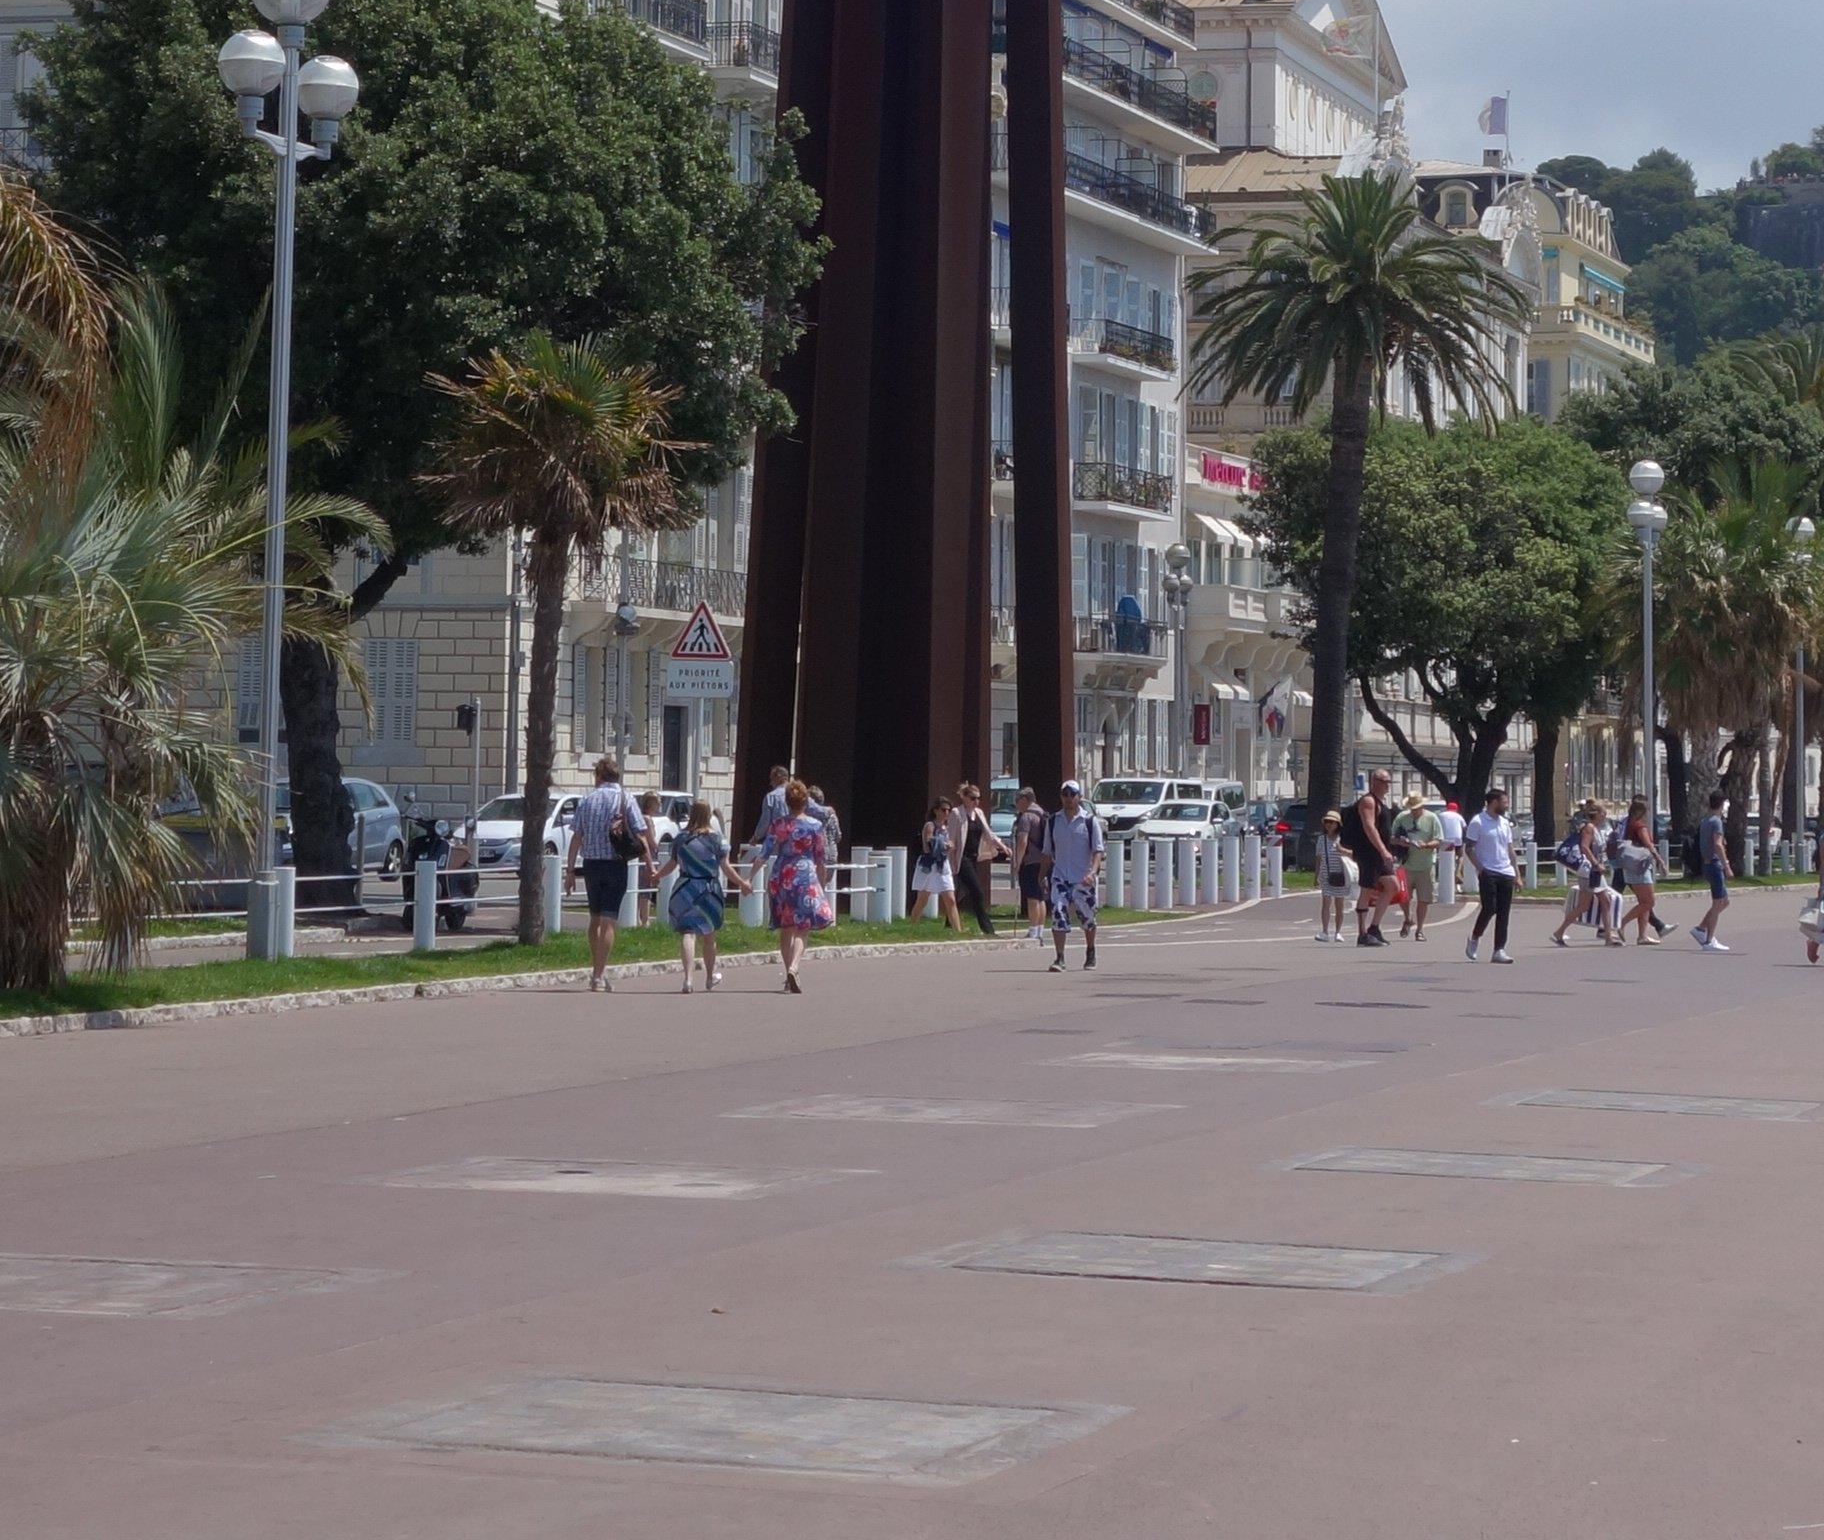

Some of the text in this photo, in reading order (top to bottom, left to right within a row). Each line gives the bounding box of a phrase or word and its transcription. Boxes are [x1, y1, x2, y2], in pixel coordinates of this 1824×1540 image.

[678, 667, 721, 677] PRIORITÉ
[669, 680, 729, 690] AUX PIÉTONS
